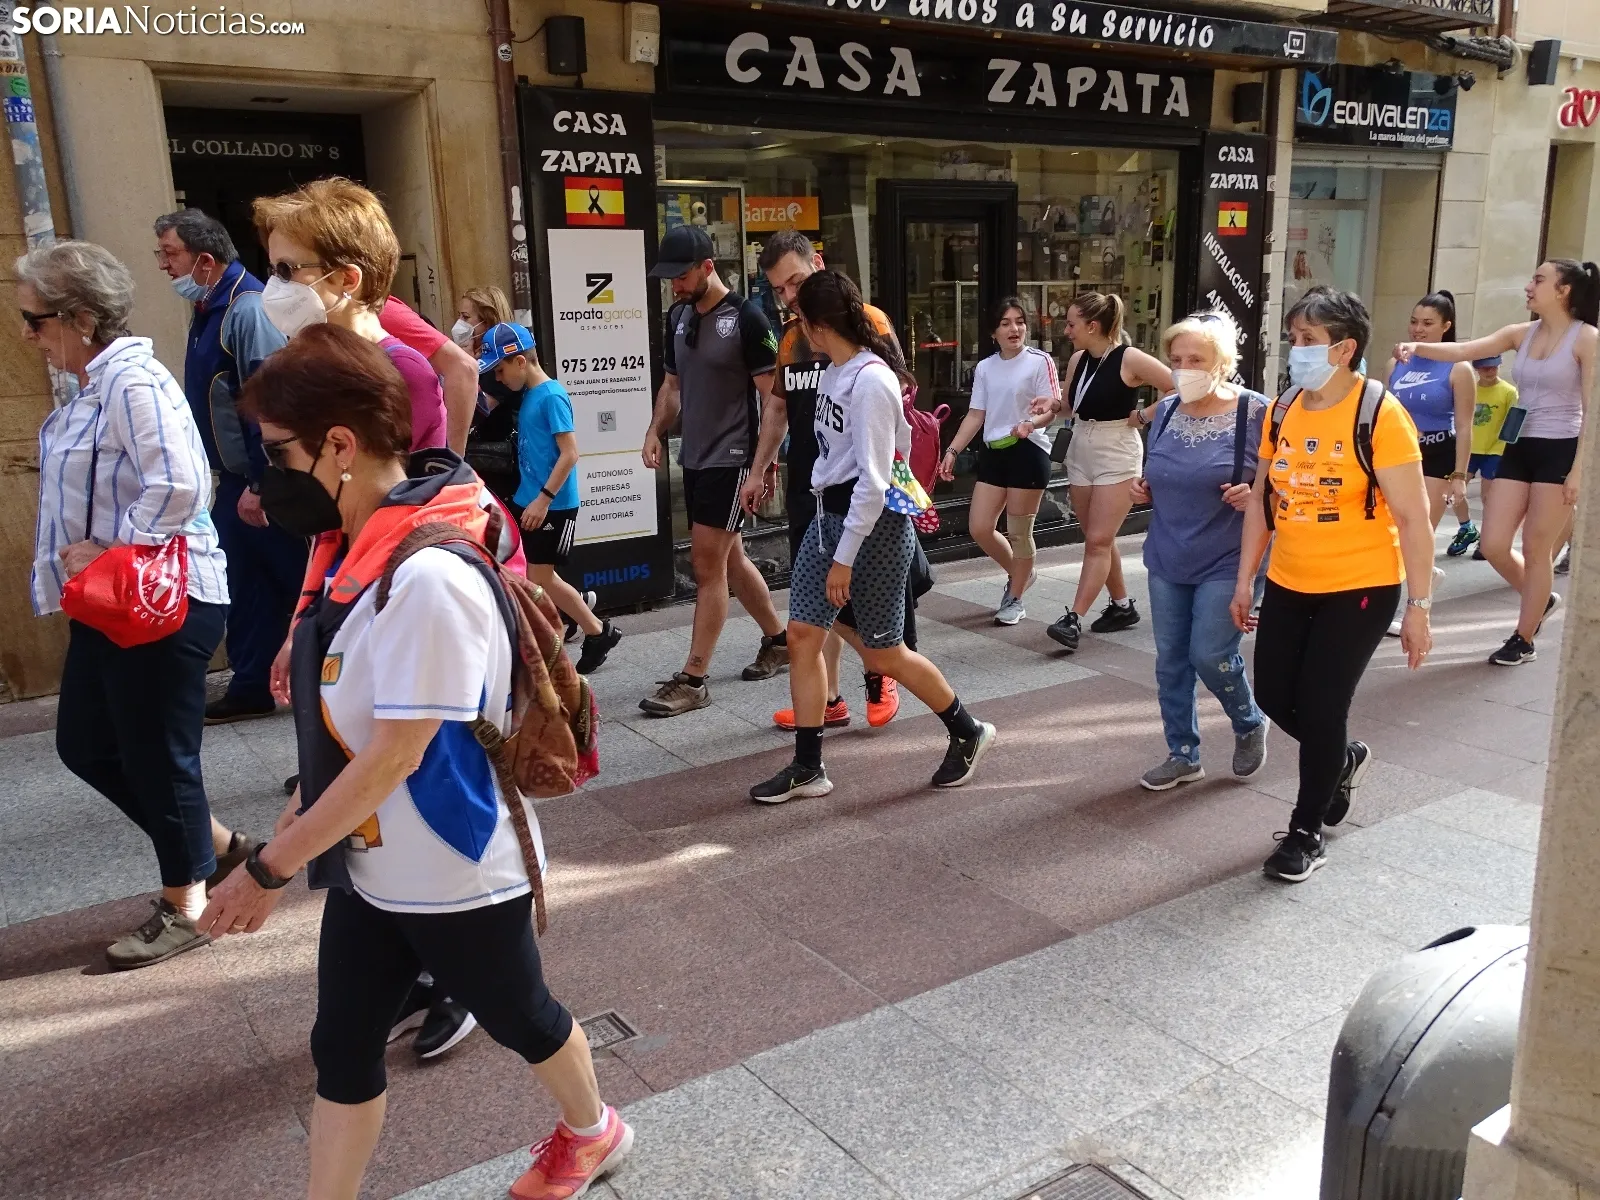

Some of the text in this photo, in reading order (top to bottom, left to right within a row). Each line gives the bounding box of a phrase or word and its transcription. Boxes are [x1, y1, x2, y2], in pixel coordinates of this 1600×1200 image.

[1015, 3, 1035, 28] a
[725, 32, 1190, 117] CASA ZAPATA
[553, 110, 627, 136] CASA
[1369, 131, 1377, 140] La
[1378, 133, 1396, 141] marca
[1425, 135, 1449, 145] perfume
[168, 138, 186, 154] L
[192, 139, 294, 158] COLLADO
[328, 146, 340, 160] 8
[1218, 145, 1255, 163] CASA
[540, 149, 642, 175] ZAPATA
[1209, 172, 1259, 190] ZAPATA
[561, 355, 645, 373] 975 229 424
[1400, 370, 1432, 382] NIKE
[586, 468, 634, 480] AUTONOMOS
[590, 482, 631, 493] EMPRESAS
[580, 493, 642, 507] DECLARACIONES
[590, 510, 634, 522] AUDITORIAS
[583, 563, 651, 589] PHILIPS
[133, 604, 165, 626] 2018
